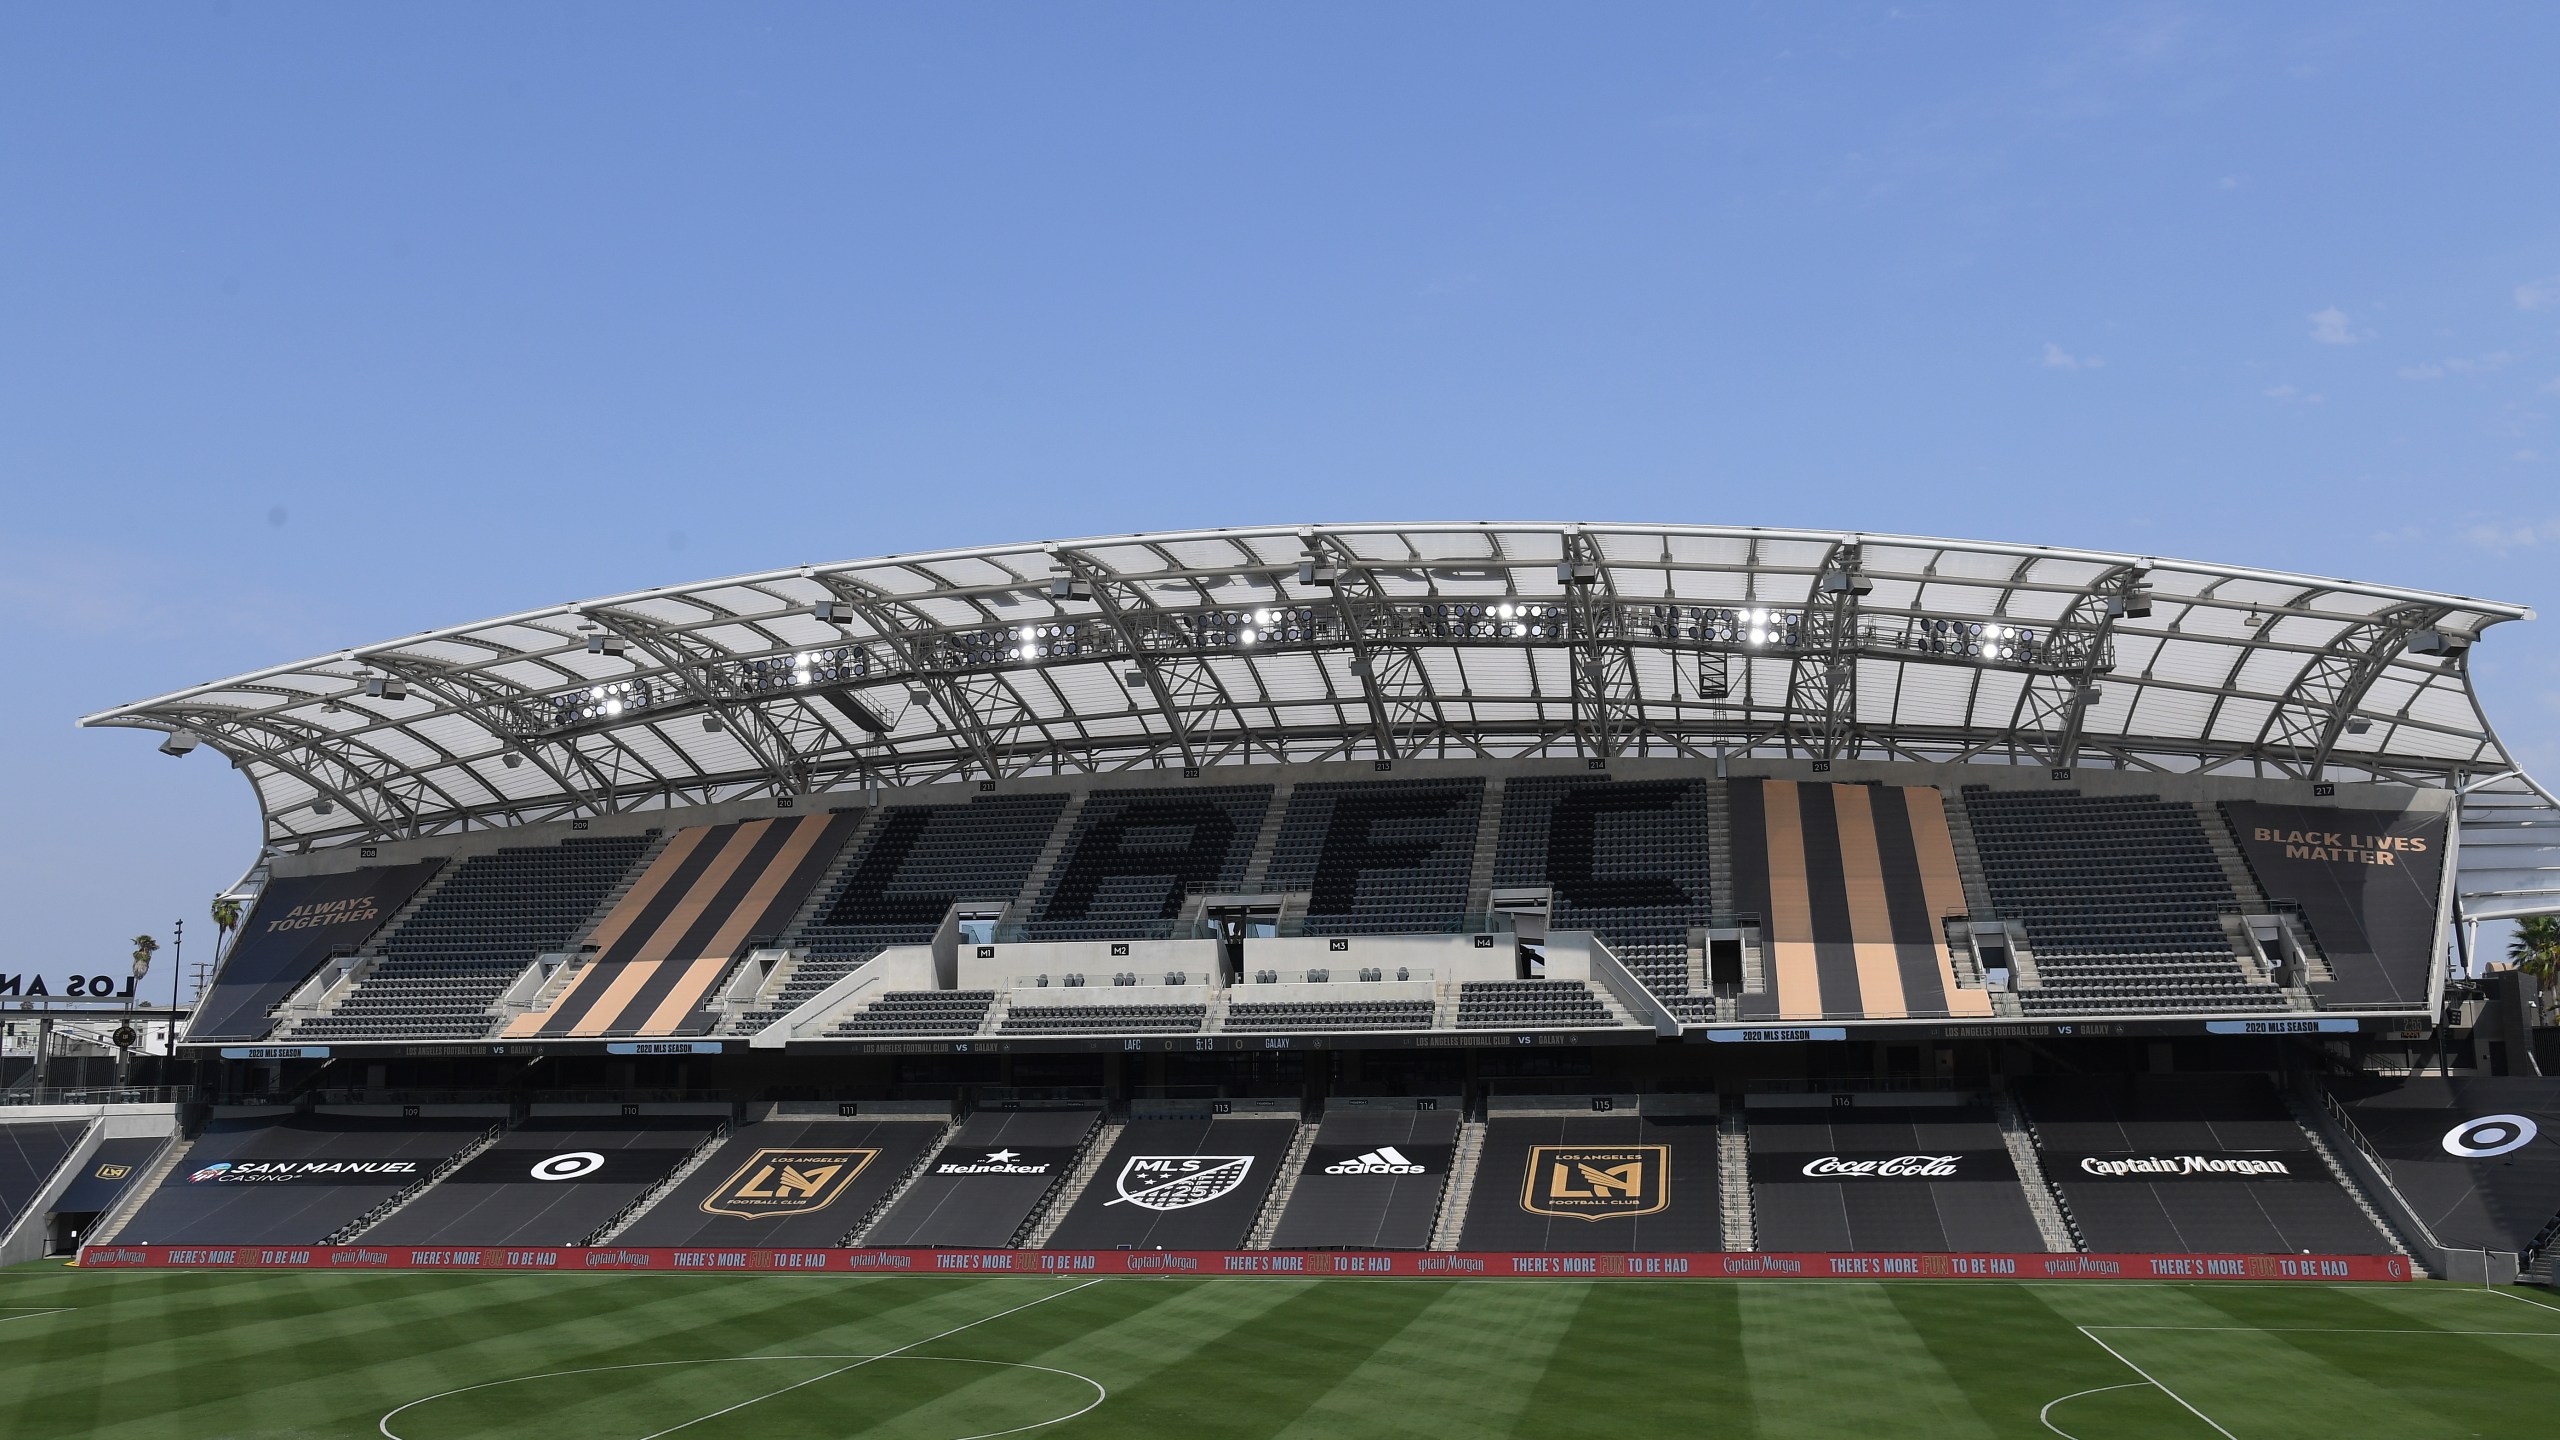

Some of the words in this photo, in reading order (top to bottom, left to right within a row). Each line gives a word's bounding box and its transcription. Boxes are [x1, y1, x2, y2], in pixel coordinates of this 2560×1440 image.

[1377, 762, 1389, 770] 213
[1590, 761, 1603, 769] 214
[1815, 763, 1828, 771] 215
[2054, 771, 2068, 779] 216
[2316, 787, 2332, 795] 217
[2255, 827, 2341, 847] BLACK
[2351, 835, 2427, 852] LIVES
[2286, 845, 2394, 865] MATTER
[287, 897, 375, 917] ALWAYS
[267, 909, 378, 932] TOGETHER
[1945, 1027, 1959, 1037] LOS
[1961, 1027, 1992, 1037] ANGELES
[1994, 1026, 2028, 1036] FOOTBALL
[2030, 1025, 2048, 1035] CLUB
[2058, 1026, 2072, 1034] VS
[2081, 1025, 2109, 1035] GALAXY
[2245, 1022, 2266, 1032] 2020
[2268, 1022, 2285, 1032] MLS
[2286, 1021, 2319, 1031] SEASON
[1416, 1037, 1428, 1047] LOS
[1430, 1037, 1457, 1046] ANGELES
[1459, 1036, 1492, 1046] FOOTBALL
[1494, 1036, 1510, 1045] CLUB
[1518, 1036, 1531, 1044] VS
[1538, 1035, 1564, 1045] GALAXY
[1743, 1031, 1762, 1041] 2020
[1763, 1030, 1779, 1040] MLS
[1781, 1030, 1810, 1040] SEASON
[636, 1044, 652, 1053] 2020
[654, 1044, 665, 1053] MLS
[667, 1044, 692, 1052] SEASON
[864, 1044, 875, 1053] LOS
[876, 1044, 901, 1053] ANGELES
[904, 1043, 932, 1052] FOOTBALL
[934, 1043, 948, 1052] CLUB
[974, 1043, 997, 1051] GALAXY
[1124, 1039, 1141, 1050] LAFC
[1165, 1040, 1172, 1050] 0
[1196, 1039, 1213, 1050] 5:13
[1236, 1039, 1243, 1049] 0
[1265, 1038, 1290, 1049] GALAXY
[249, 1049, 264, 1058] 2020
[265, 1049, 277, 1058] MLS
[278, 1049, 301, 1057] SEASON
[407, 1047, 416, 1056] LOS
[418, 1047, 441, 1056] ANGELES
[443, 1047, 469, 1056] FOOTBALL
[470, 1046, 486, 1055] CLUB
[510, 1045, 532, 1054] GALAXY
[1419, 1102, 1434, 1110] 114
[1595, 1100, 1610, 1110] 115
[1835, 1097, 1850, 1106] 116
[405, 1108, 418, 1117] 109
[624, 1106, 637, 1116] 110
[841, 1106, 854, 1115] 111
[1215, 1104, 1229, 1113] 113
[231, 1163, 294, 1173] SAN
[297, 1162, 417, 1173] MANUEL
[936, 1164, 1046, 1174] Heineken
[1134, 1160, 1201, 1171] MLS
[1324, 1162, 1426, 1174] adidas
[1802, 1155, 1963, 1177] Coca-Cola
[2081, 1157, 2180, 1176] Captain
[2174, 1156, 2290, 1176] Morgan
[87, 1250, 115, 1265] aptain
[115, 1249, 146, 1264] Morgan
[168, 1251, 206, 1264] THERE'S
[208, 1251, 235, 1264] MORE
[237, 1248, 257, 1264] FUN
[261, 1251, 272, 1264] TO
[275, 1251, 287, 1264] BE
[290, 1251, 309, 1264] HAD
[355, 1249, 387, 1265] Morgan
[411, 1251, 450, 1265] THERE'S
[452, 1252, 481, 1265] MORE
[483, 1249, 504, 1266] FUN
[507, 1252, 519, 1265] TO
[521, 1252, 534, 1265] BE
[536, 1252, 556, 1265] HAD
[585, 1251, 616, 1267] Captain
[615, 1251, 649, 1266] Morgan
[673, 1253, 714, 1266] THERE'S
[717, 1253, 746, 1266] MORE
[749, 1251, 772, 1268] FUN
[774, 1253, 786, 1266] TO
[789, 1254, 802, 1266] BE
[805, 1254, 825, 1267] HAD
[876, 1252, 911, 1268] Morgan
[937, 1254, 979, 1268] THERE'S
[982, 1255, 1012, 1268] MORE
[1015, 1253, 1038, 1270] FUN
[1041, 1255, 1054, 1269] TO
[1057, 1255, 1070, 1269] BE
[1073, 1256, 1095, 1269] HAD
[1127, 1254, 1161, 1270] Captain
[1161, 1254, 1197, 1271] Morgan
[1224, 1256, 1268, 1270] THERE'S
[1272, 1257, 1303, 1271] MORE
[1307, 1254, 1331, 1272] FUN
[1334, 1257, 1348, 1271] TO
[1351, 1257, 1364, 1271] BE
[1368, 1257, 1391, 1272] HAD
[1445, 1255, 1484, 1272] Morgan
[1512, 1258, 1560, 1272] THERE'S
[1563, 1258, 1596, 1272] MORE
[1600, 1255, 1625, 1274] FUN
[1628, 1258, 1642, 1272] TO
[1646, 1258, 1660, 1272] BE
[1664, 1258, 1688, 1273] HAD
[1723, 1257, 1762, 1273] Captain
[1761, 1256, 1801, 1273] Morgan
[1830, 1259, 1881, 1273] THERE'S
[1884, 1259, 1918, 1273] MORE
[1922, 1256, 1949, 1275] FUN
[1952, 1259, 1968, 1273] TO
[1972, 1259, 1987, 1273] BE
[1991, 1259, 2016, 1274] HAD
[2076, 1257, 2120, 1275] Morgan
[2150, 1259, 2204, 1274] THERE'S
[2208, 1260, 2245, 1275] MORE
[2249, 1257, 2277, 1277] FUN
[2280, 1260, 2296, 1275] TO
[2301, 1260, 2316, 1276] BE
[2321, 1261, 2349, 1276] HAD
